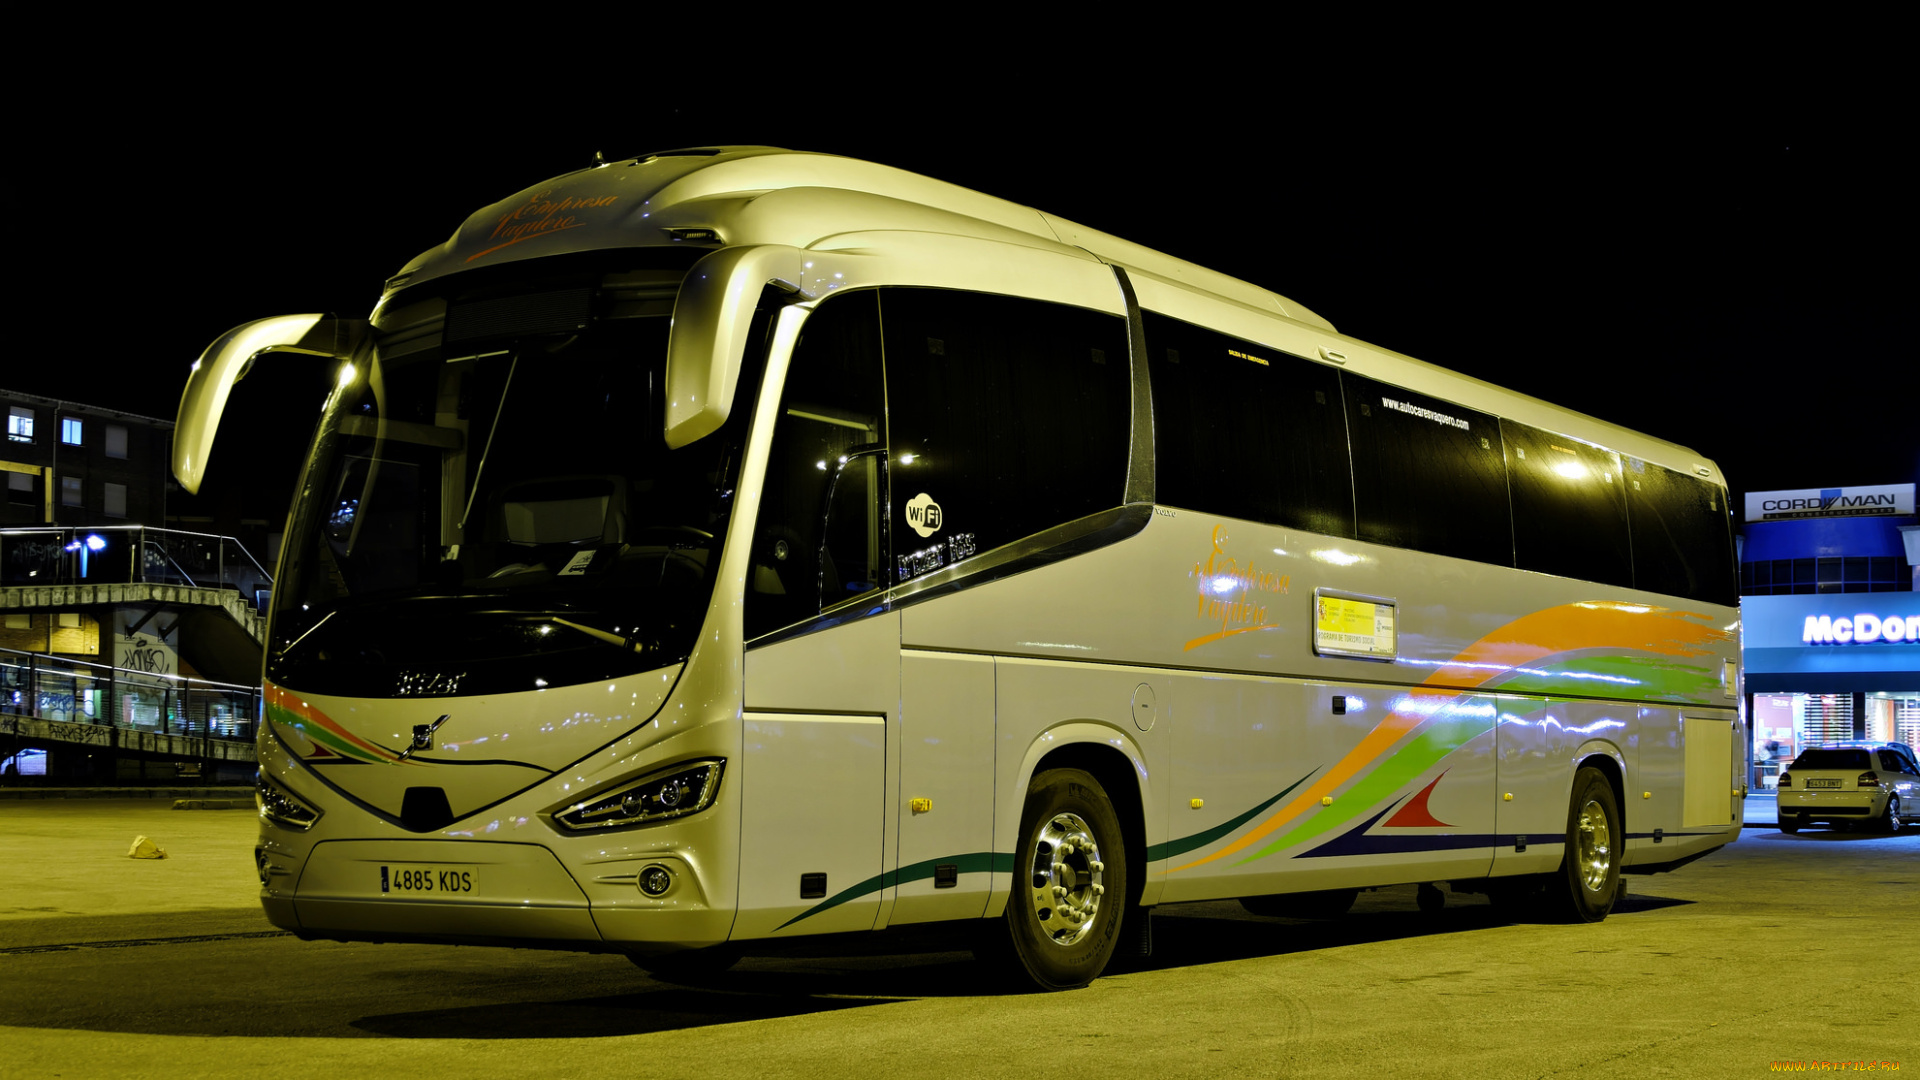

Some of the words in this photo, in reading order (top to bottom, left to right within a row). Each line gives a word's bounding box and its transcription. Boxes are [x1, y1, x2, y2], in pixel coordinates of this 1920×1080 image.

[514, 190, 619, 222] Empresa
[1381, 396, 1470, 431] www.autocaresvaquero.com
[394, 870, 434, 891] 4885
[439, 871, 473, 892] KDS
